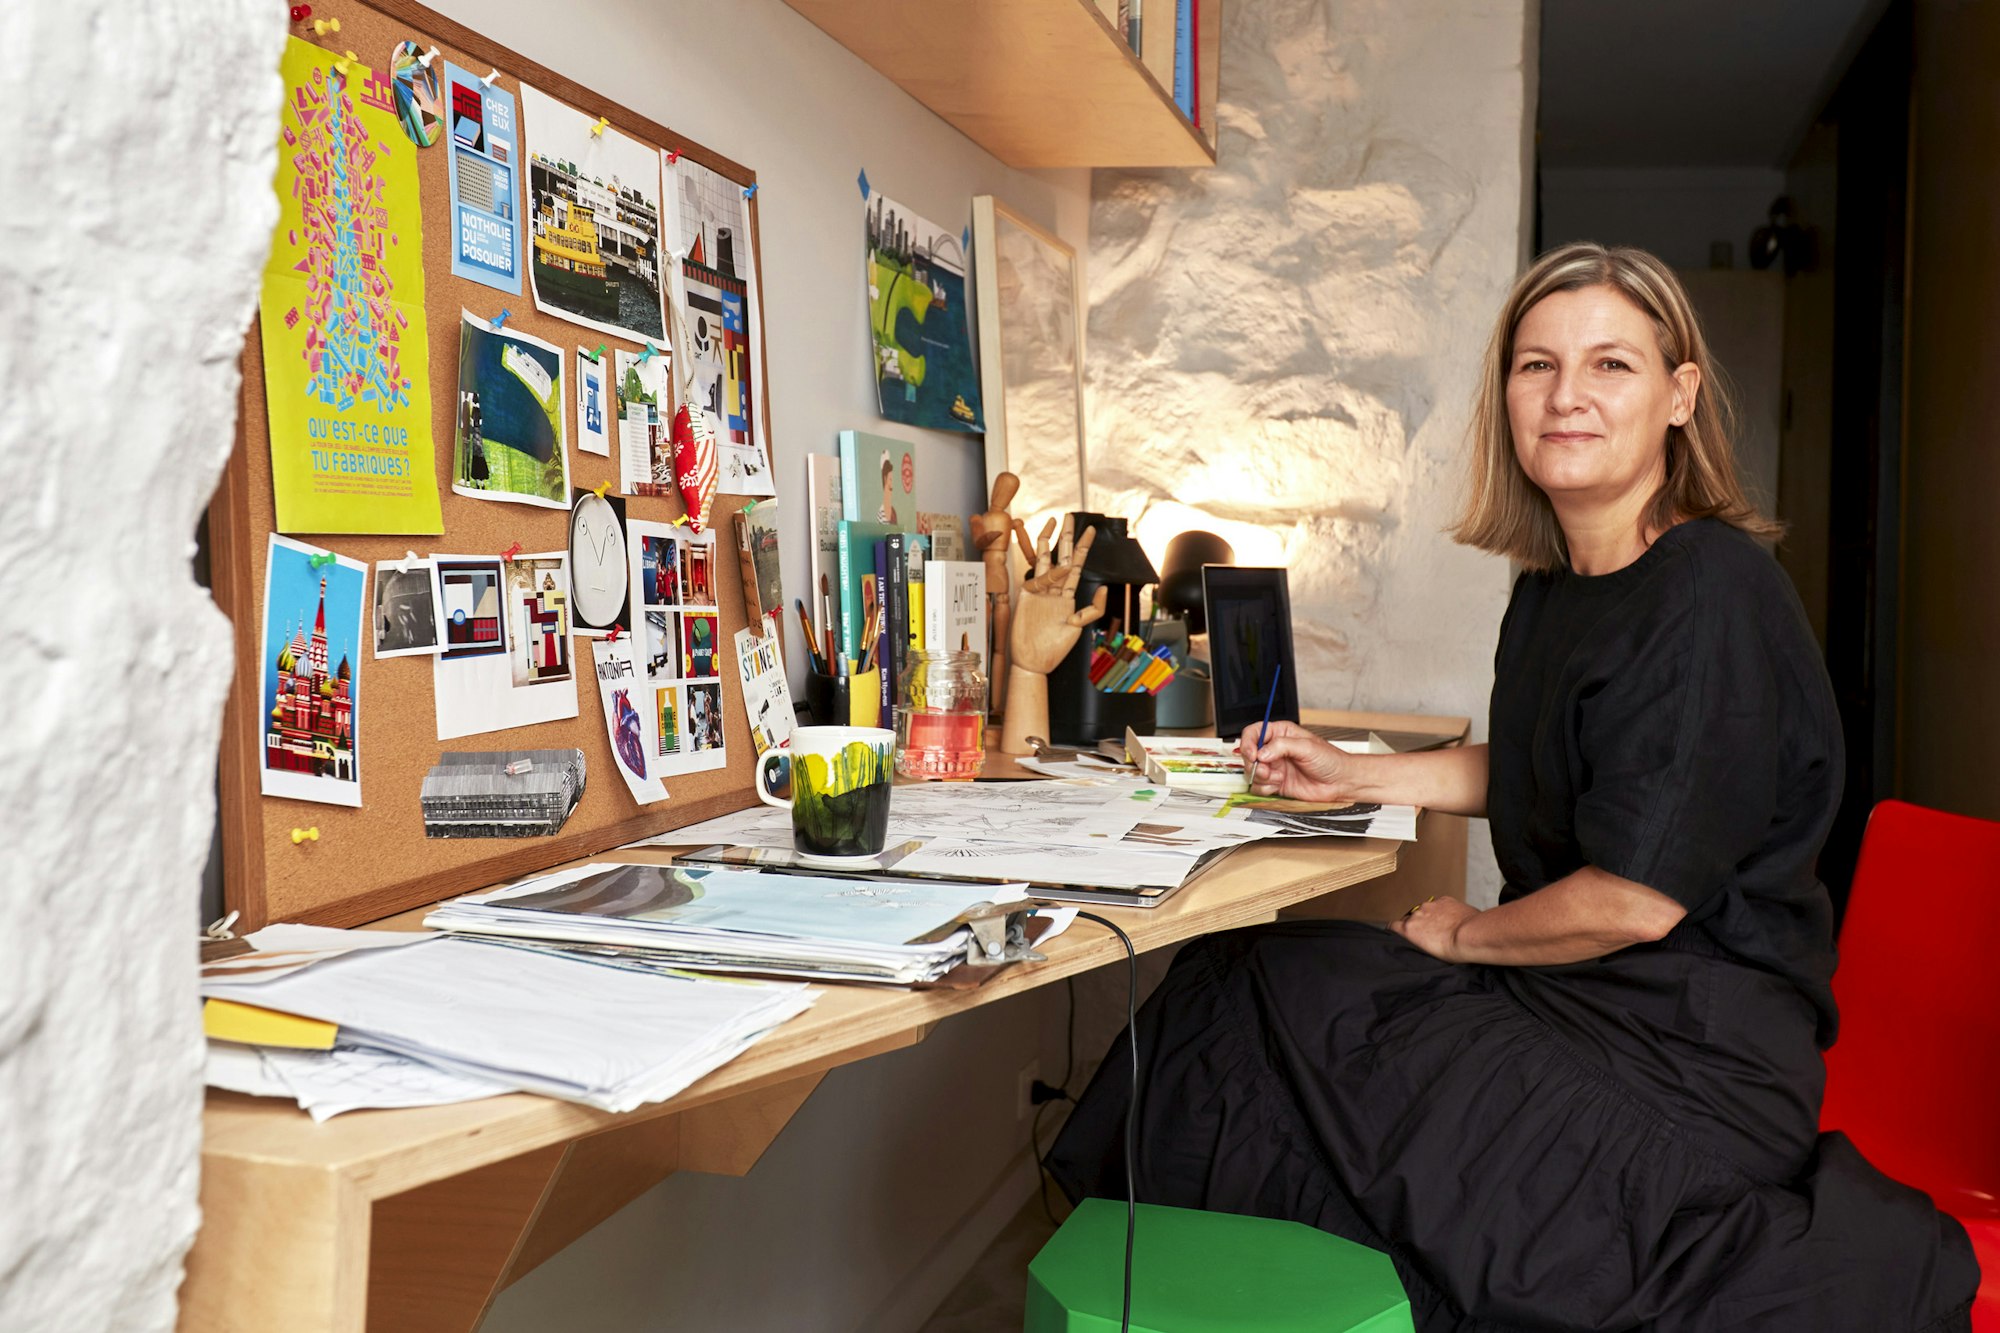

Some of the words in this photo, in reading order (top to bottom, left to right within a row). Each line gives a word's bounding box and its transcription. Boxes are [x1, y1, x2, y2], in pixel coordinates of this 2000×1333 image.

[485, 97, 510, 118] CHEZ
[492, 113, 510, 132] EUX
[311, 450, 329, 471] TU
[841, 550, 849, 592] HAUGHTON
[742, 641, 778, 682] SYDNEY
